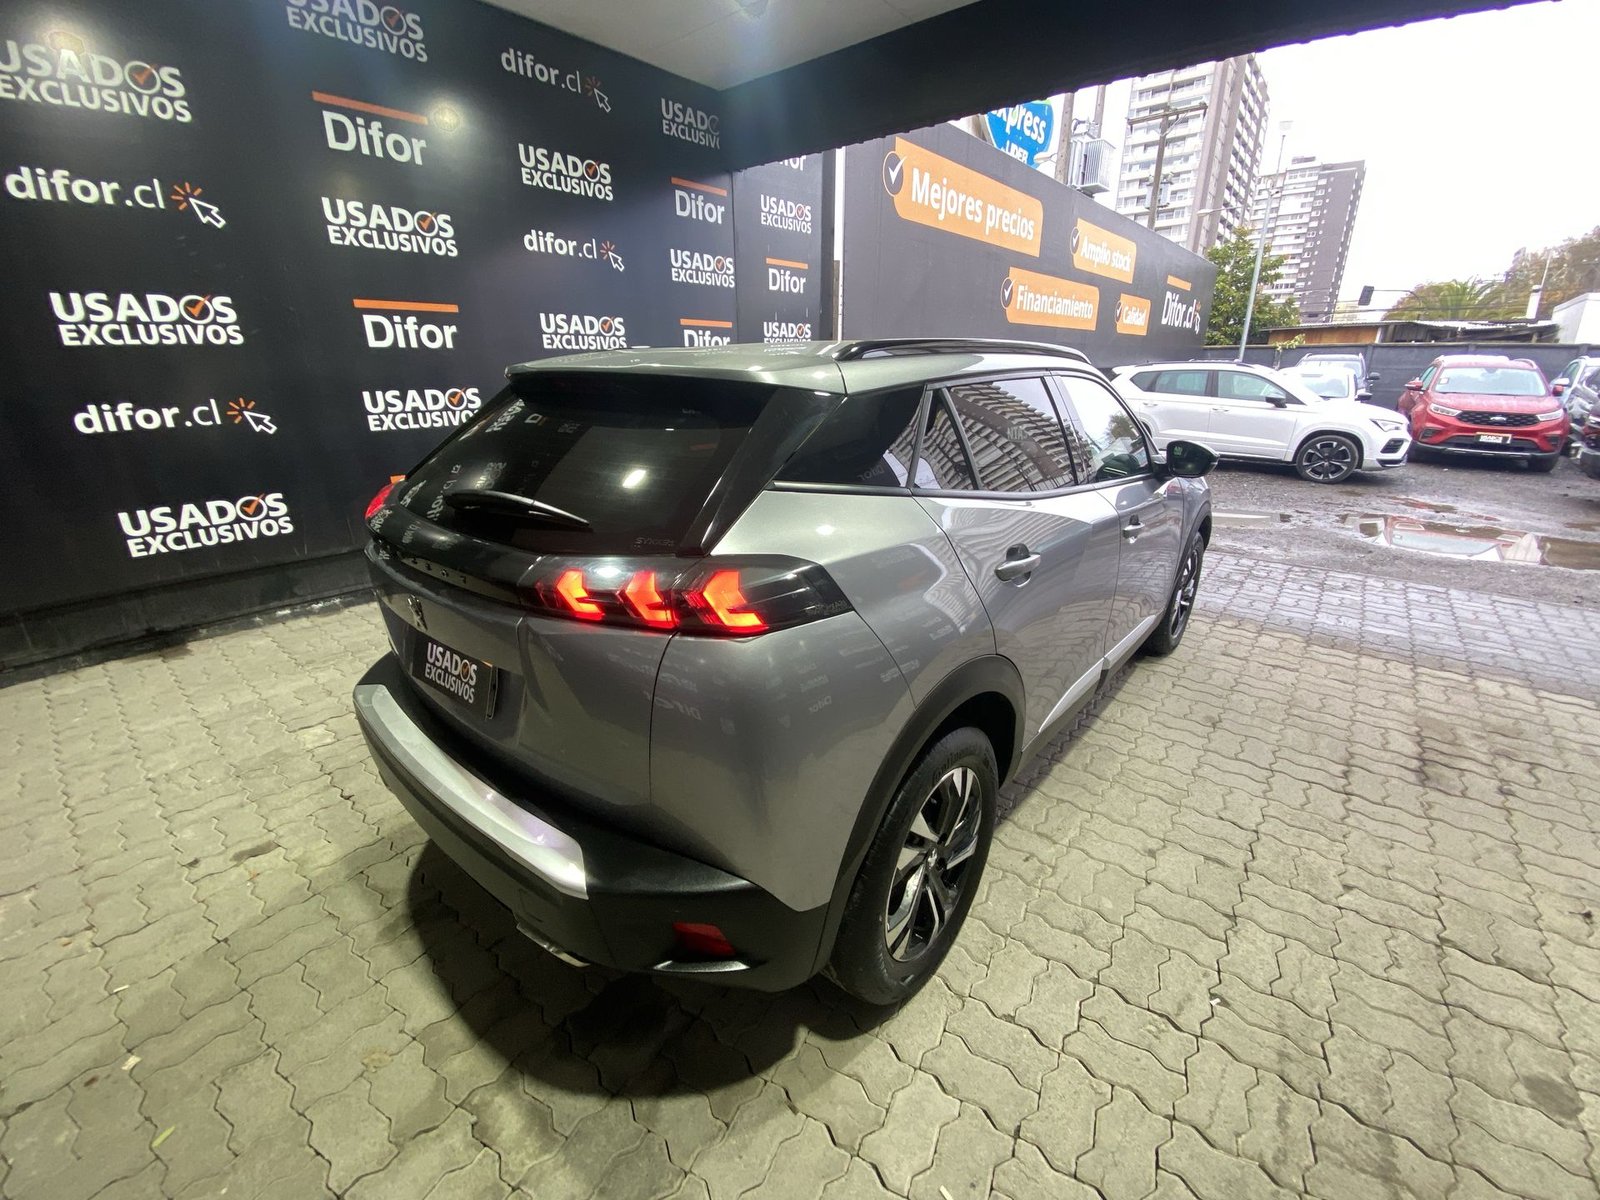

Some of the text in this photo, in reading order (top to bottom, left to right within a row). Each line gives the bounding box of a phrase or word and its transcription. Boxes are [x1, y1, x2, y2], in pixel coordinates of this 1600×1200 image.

[286, 6, 428, 62] EXCLUSIVOS
[0, 40, 186, 98] USADOS
[501, 48, 581, 93] difor.cl
[0, 74, 192, 123] EXCLUSIVOS
[661, 97, 720, 135] USADO
[322, 110, 427, 165] Difor
[662, 119, 720, 149] EXCLUSIV
[991, 105, 1047, 145] xpress
[518, 143, 612, 185] USADOS
[5, 166, 165, 210] difor.cl
[521, 167, 613, 201] EXCLUSIVOS
[321, 197, 455, 238] USADOS
[674, 189, 725, 224] Difor
[760, 194, 812, 221] USADOS
[911, 168, 1035, 241] Mejores precios
[327, 225, 458, 257] EXCLUSIVOS
[761, 213, 812, 234] EXCLUSIVOS
[523, 229, 597, 259] difor.cl
[670, 248, 734, 275] USADOS
[1080, 236, 1133, 272] Amplio stock
[671, 267, 735, 288] EXCLUSIVOS
[768, 268, 806, 293] Difor
[49, 292, 237, 325] USADOS
[1016, 284, 1094, 320] Financiamiento
[1122, 305, 1147, 326] Calidad
[1161, 290, 1196, 329] Difor.cl
[58, 323, 244, 346] EXCLUSIVOS
[363, 314, 457, 349] Difor
[539, 313, 625, 337] USADOS
[542, 333, 627, 350] EXCLUSIVOS
[763, 321, 812, 339] USADOS
[73, 399, 221, 434] difor.cl
[362, 387, 482, 414] USADOS
[367, 410, 478, 432] EXCLUSIVO
[118, 493, 288, 537] USADOS
[127, 516, 293, 558] EXCLUSIVOS
[426, 642, 478, 686] USADOS
[424, 662, 475, 704] EXCLUSIVOS
